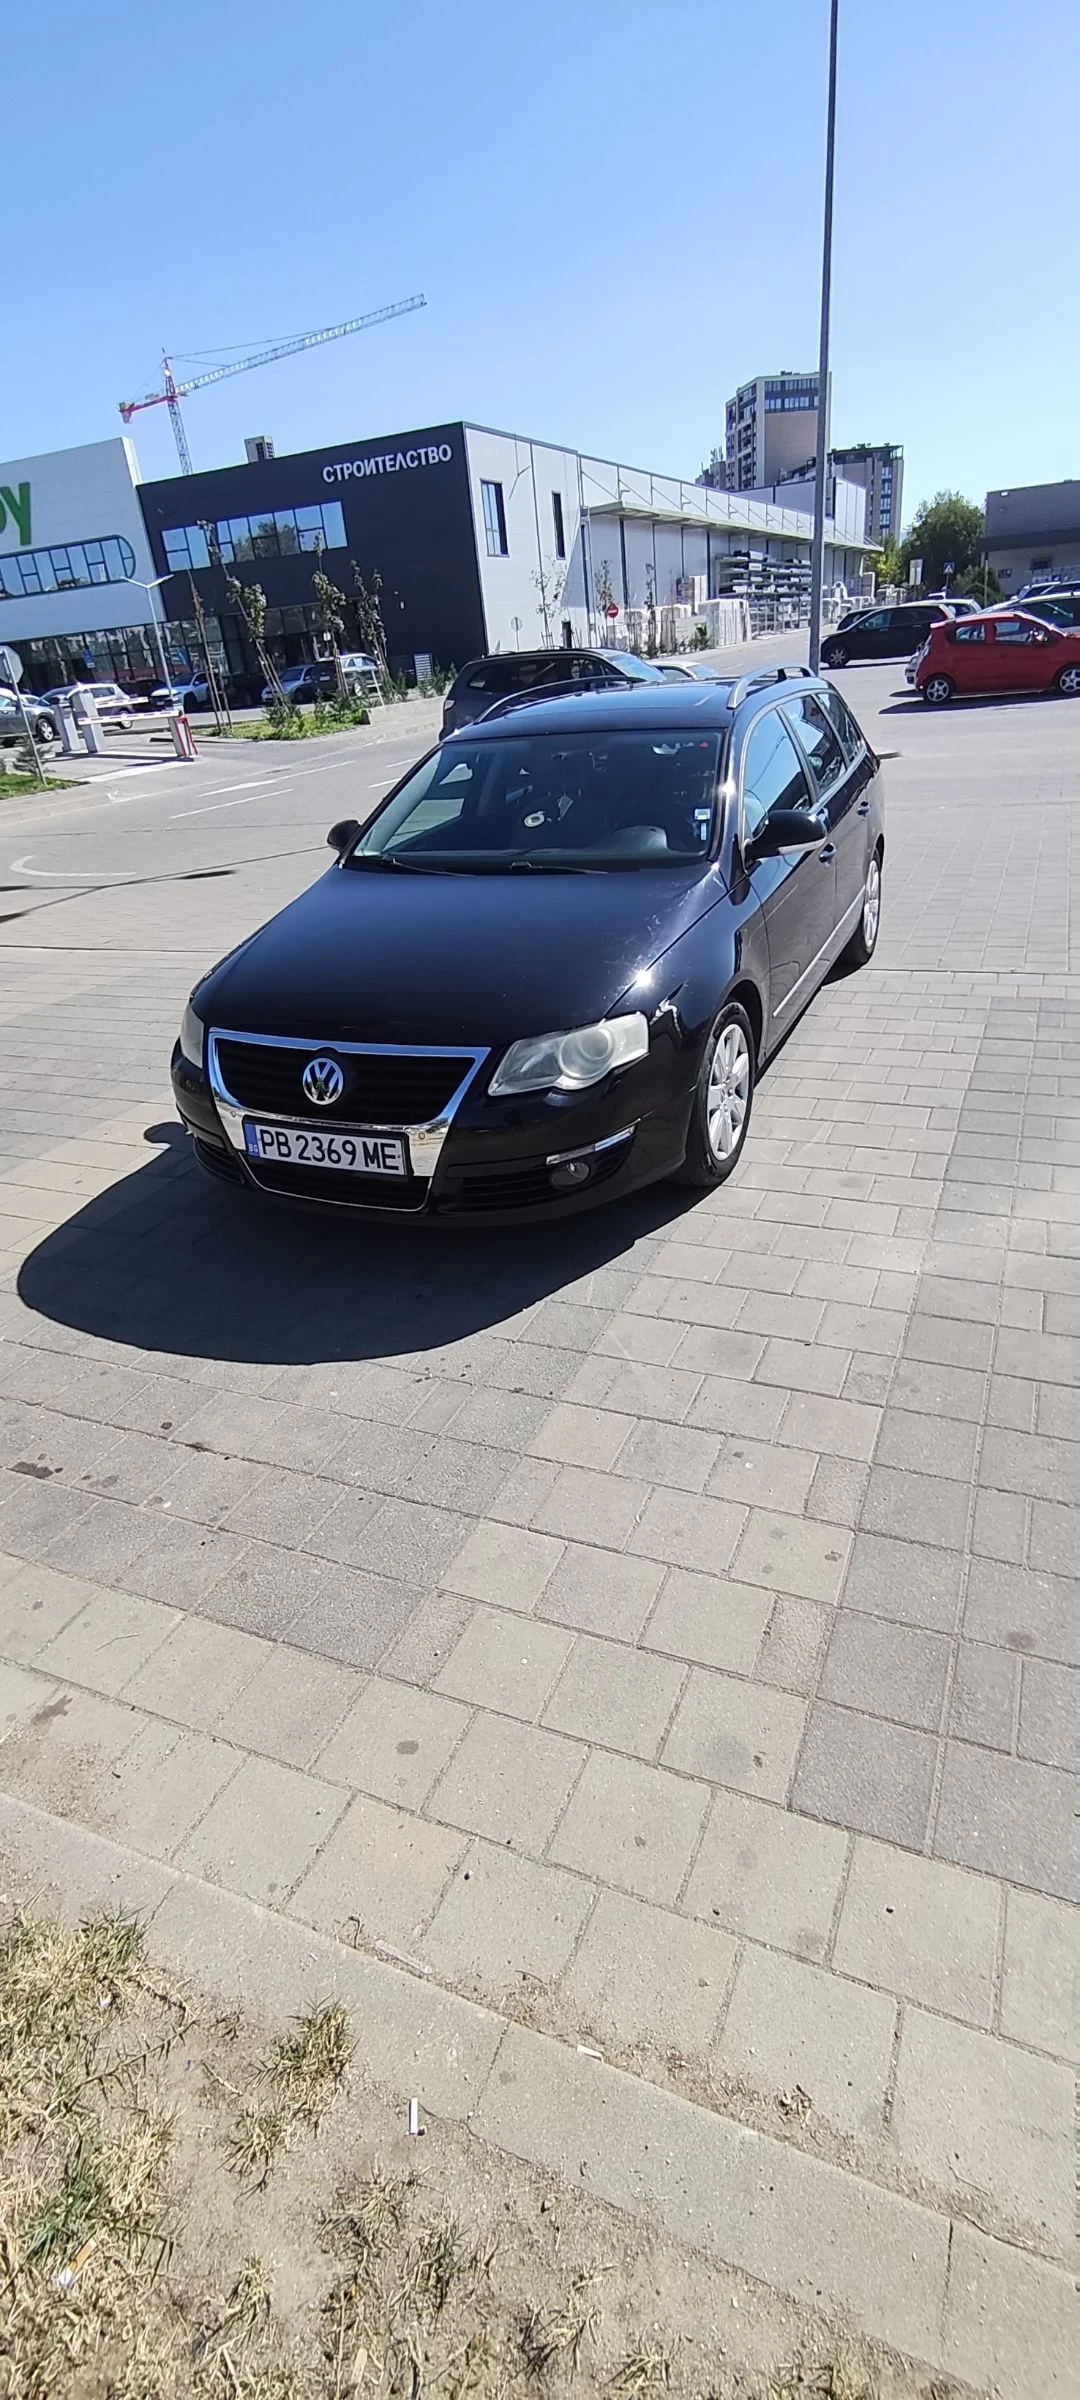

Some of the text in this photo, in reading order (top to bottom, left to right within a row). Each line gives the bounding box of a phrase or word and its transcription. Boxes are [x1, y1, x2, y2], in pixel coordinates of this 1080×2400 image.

[322, 443, 453, 483] СТРОИТЕЛСТВО
[303, 1057, 344, 1106] VW
[248, 1142, 259, 1153] BG
[259, 1129, 399, 1170] PB 2369 ME
